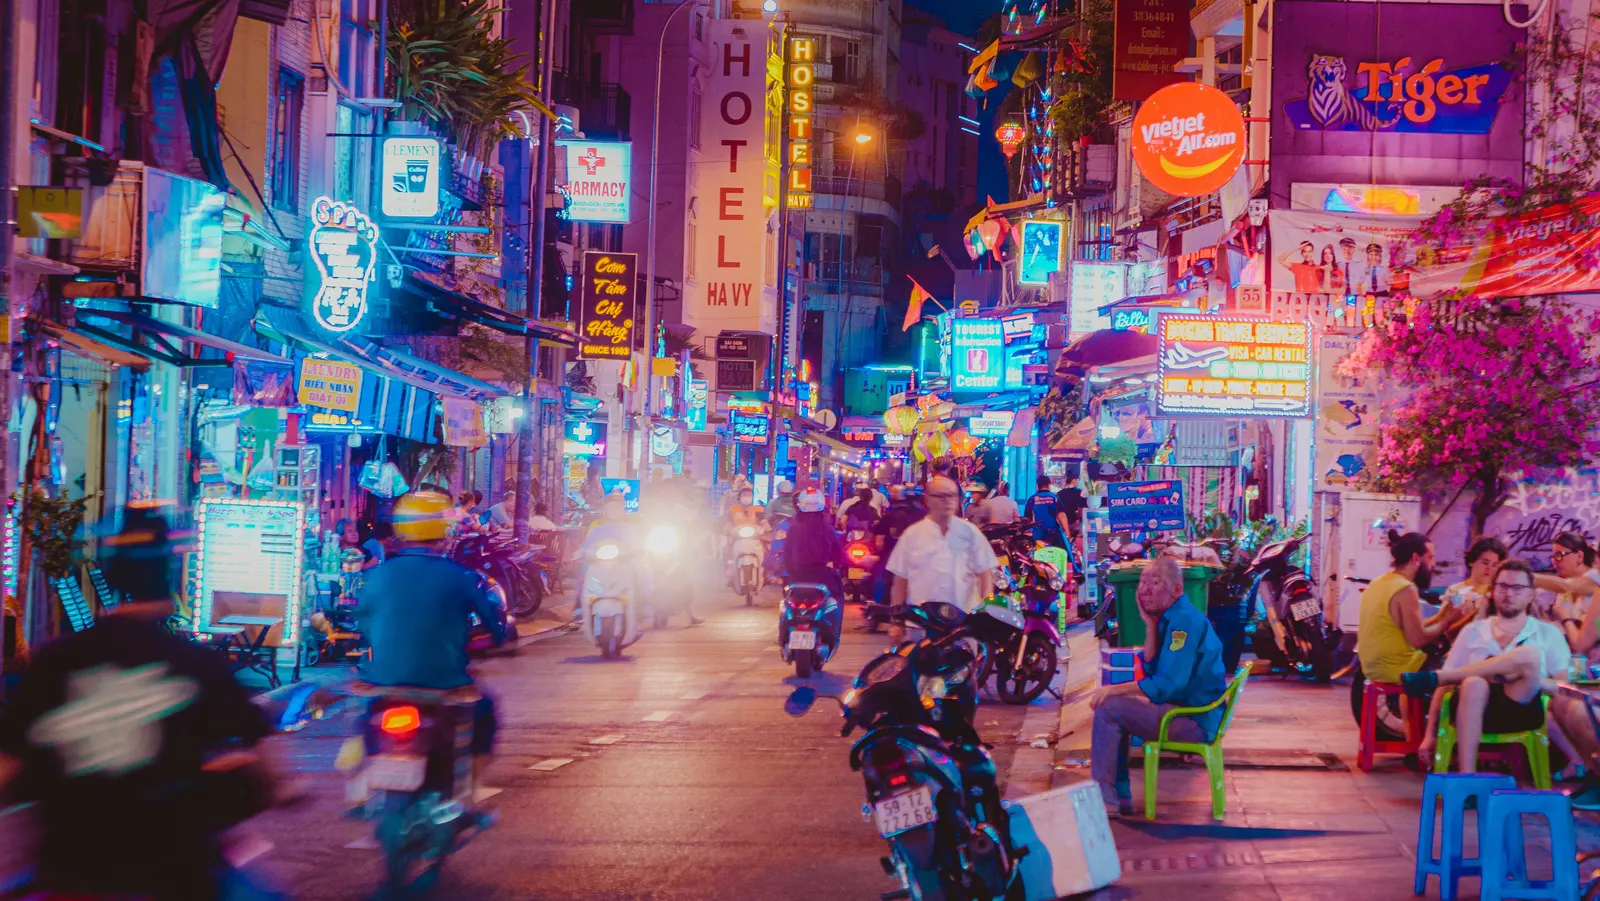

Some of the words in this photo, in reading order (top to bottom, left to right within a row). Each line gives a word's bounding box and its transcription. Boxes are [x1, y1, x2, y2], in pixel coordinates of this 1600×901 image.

[1133, 12, 1174, 22] 38364841
[1357, 57, 1490, 122] Tiger
[792, 40, 811, 189] HOSTEL
[1176, 132, 1236, 156] Air.com
[717, 43, 752, 268] HOTEL
[788, 195, 810, 208] HAVY
[1242, 288, 1260, 302] 55
[955, 324, 1001, 334] TOURIST
[583, 345, 610, 354] SINCE
[610, 346, 630, 356] 1993
[1324, 341, 1350, 350] DAILY
[1228, 345, 1249, 360] VISA
[1255, 346, 1272, 360] CAR
[1274, 347, 1306, 362] RENTAL
[304, 361, 358, 381] LAUNDRY
[720, 362, 752, 371] HOTEL
[955, 374, 1000, 387] Center
[1110, 498, 1124, 506] SIM
[1126, 498, 1146, 506] CARD
[208, 507, 236, 516] Happy
